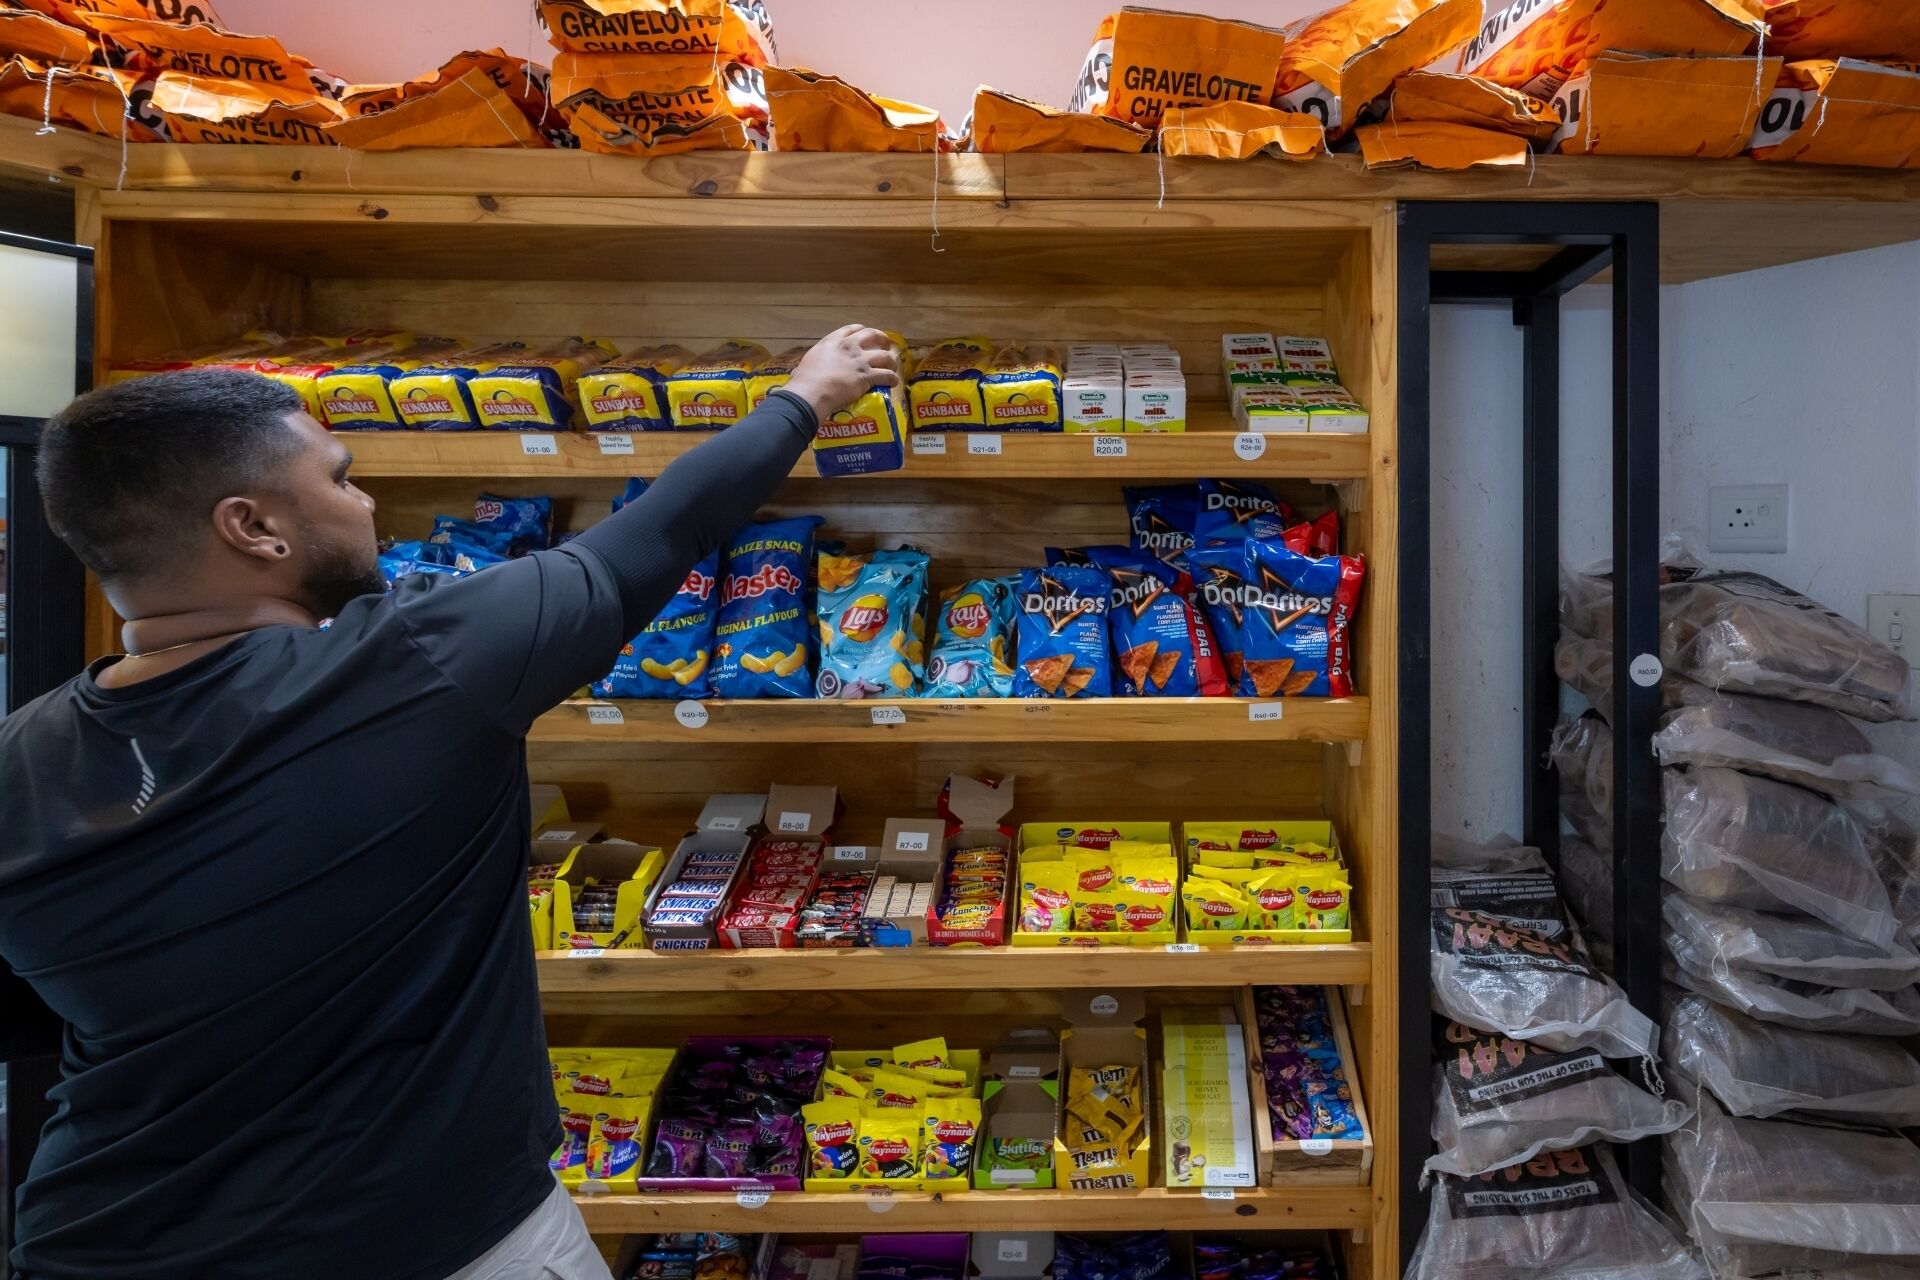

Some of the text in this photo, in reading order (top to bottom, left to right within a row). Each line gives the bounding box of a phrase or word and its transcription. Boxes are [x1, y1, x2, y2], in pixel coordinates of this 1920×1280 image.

[1124, 65, 1262, 101] GRAVELOTTE
[326, 401, 378, 414] SUNBAKE
[402, 400, 451, 414] SUNBAKE
[484, 403, 536, 417] SUNBAKE
[594, 398, 644, 414] SUNBAKE
[683, 405, 736, 418] SUNBAKE
[919, 405, 970, 418] SUNBAKE
[995, 405, 1047, 418] SUNBAKE
[1082, 406, 1104, 415] milk
[1144, 407, 1167, 416] milk
[817, 422, 876, 438] SUNBAKE
[526, 446, 551, 454] R21-00
[1096, 447, 1123, 455] R20,00
[837, 452, 872, 465] BROWN
[1207, 493, 1282, 517] Doritos
[1111, 574, 1170, 609] Dorit
[1025, 593, 1106, 614] Doritos
[1244, 585, 1333, 615] Doritos
[754, 607, 800, 627] FLAVOUR
[1196, 629, 1211, 657] BAG
[1332, 648, 1343, 676] BAG
[939, 703, 965, 711] R27-00
[590, 710, 621, 720] R25,00
[873, 710, 904, 719] R27,00
[782, 822, 805, 830] R8-00
[1075, 834, 1123, 844] Maynards
[1241, 836, 1281, 844] aynards
[841, 850, 864, 859] R7-00
[686, 866, 734, 877] SNICKERS
[668, 882, 723, 895] SNICKERS
[1131, 883, 1175, 893] Maynards
[660, 898, 717, 910] SNICKERS
[1030, 891, 1072, 905] Maynards
[1304, 896, 1345, 904] Maynards
[952, 904, 996, 916] Lunch Bar
[1122, 912, 1167, 921] Maynards
[1512, 920, 1548, 930] PERFEC
[655, 938, 707, 950] SNICKERS
[1477, 1058, 1595, 1098] TEARS OF THE TRADING
[572, 1079, 611, 1093] Maynards
[600, 1121, 640, 1134] Maynards
[933, 1127, 977, 1137] Maynards
[812, 1127, 856, 1142] Maynards
[617, 1145, 631, 1158] jelly
[710, 1138, 752, 1152] Allsorts
[867, 1145, 912, 1156] Maynards
[998, 1143, 1046, 1157] Skittles
[613, 1151, 640, 1165] teddies
[837, 1149, 853, 1161] wine
[954, 1149, 970, 1160] wine
[840, 1156, 856, 1168] duos
[885, 1164, 908, 1178] original
[1207, 1190, 1232, 1198] R60-00
[1473, 1184, 1592, 1205] TEARS OF THE TRADING
